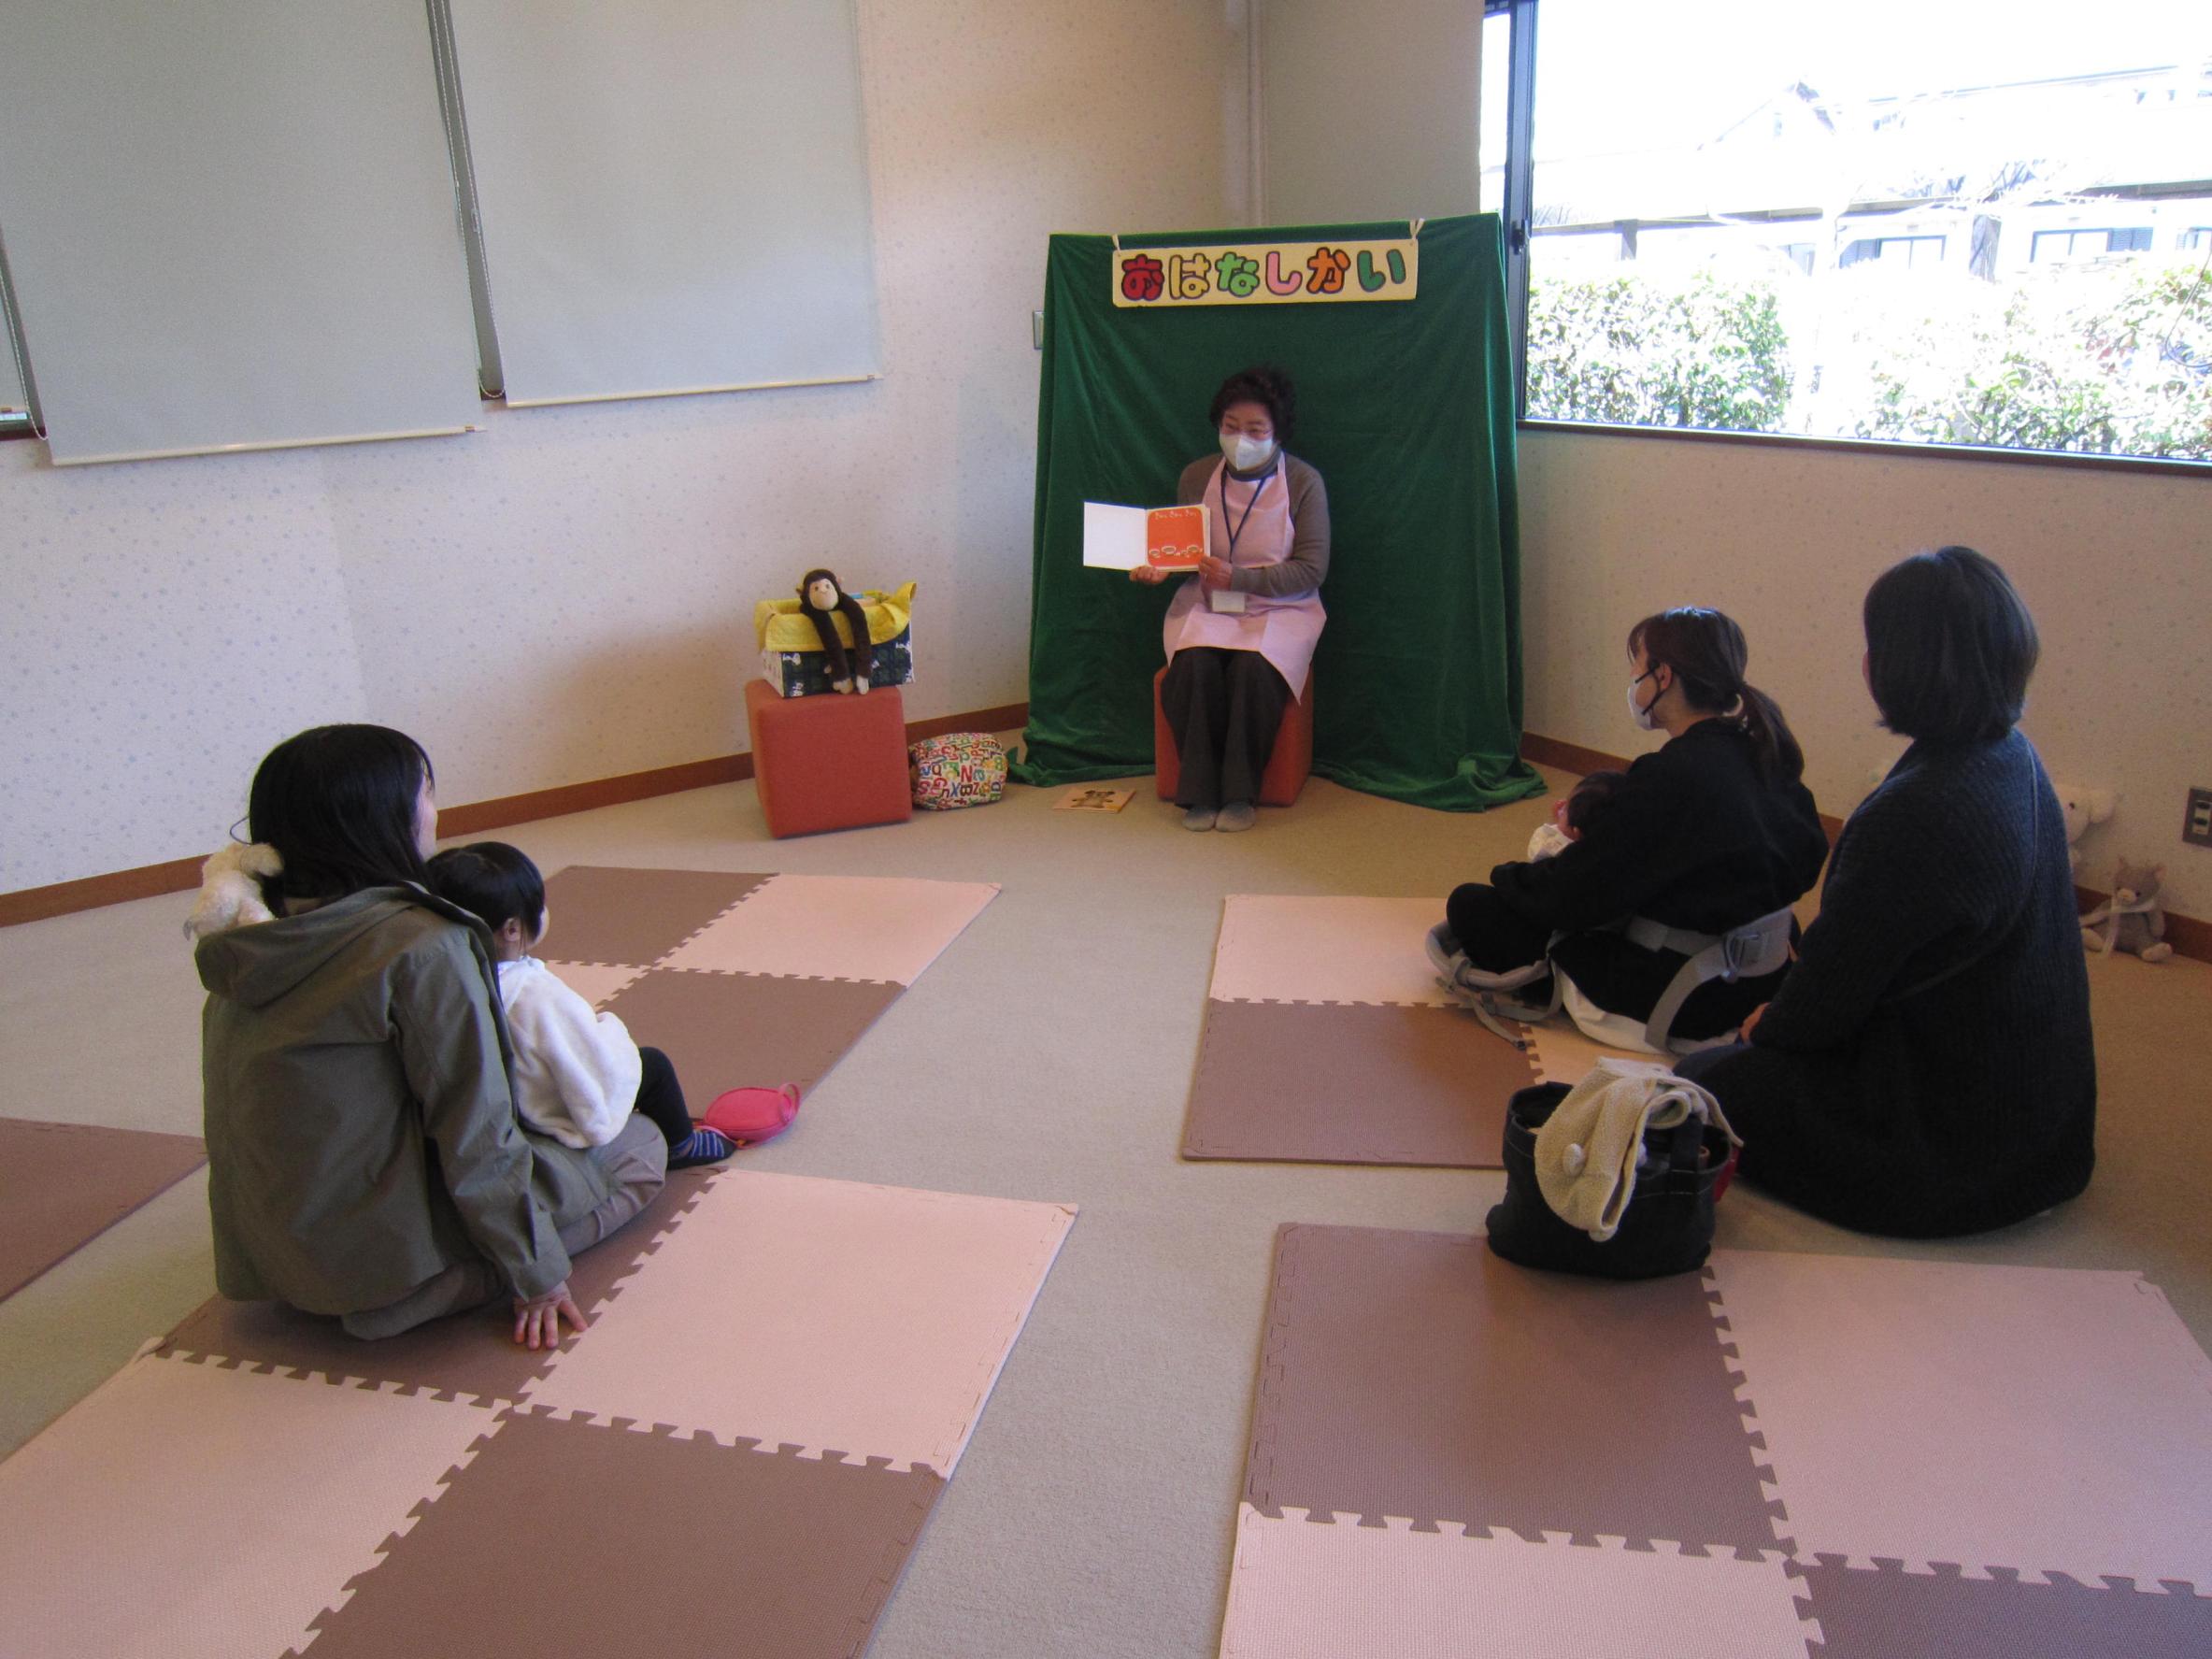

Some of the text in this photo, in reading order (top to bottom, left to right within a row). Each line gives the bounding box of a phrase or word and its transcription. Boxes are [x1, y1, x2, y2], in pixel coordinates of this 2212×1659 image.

[1121, 247, 1406, 301] おはなしかい
[961, 765, 973, 783] N
